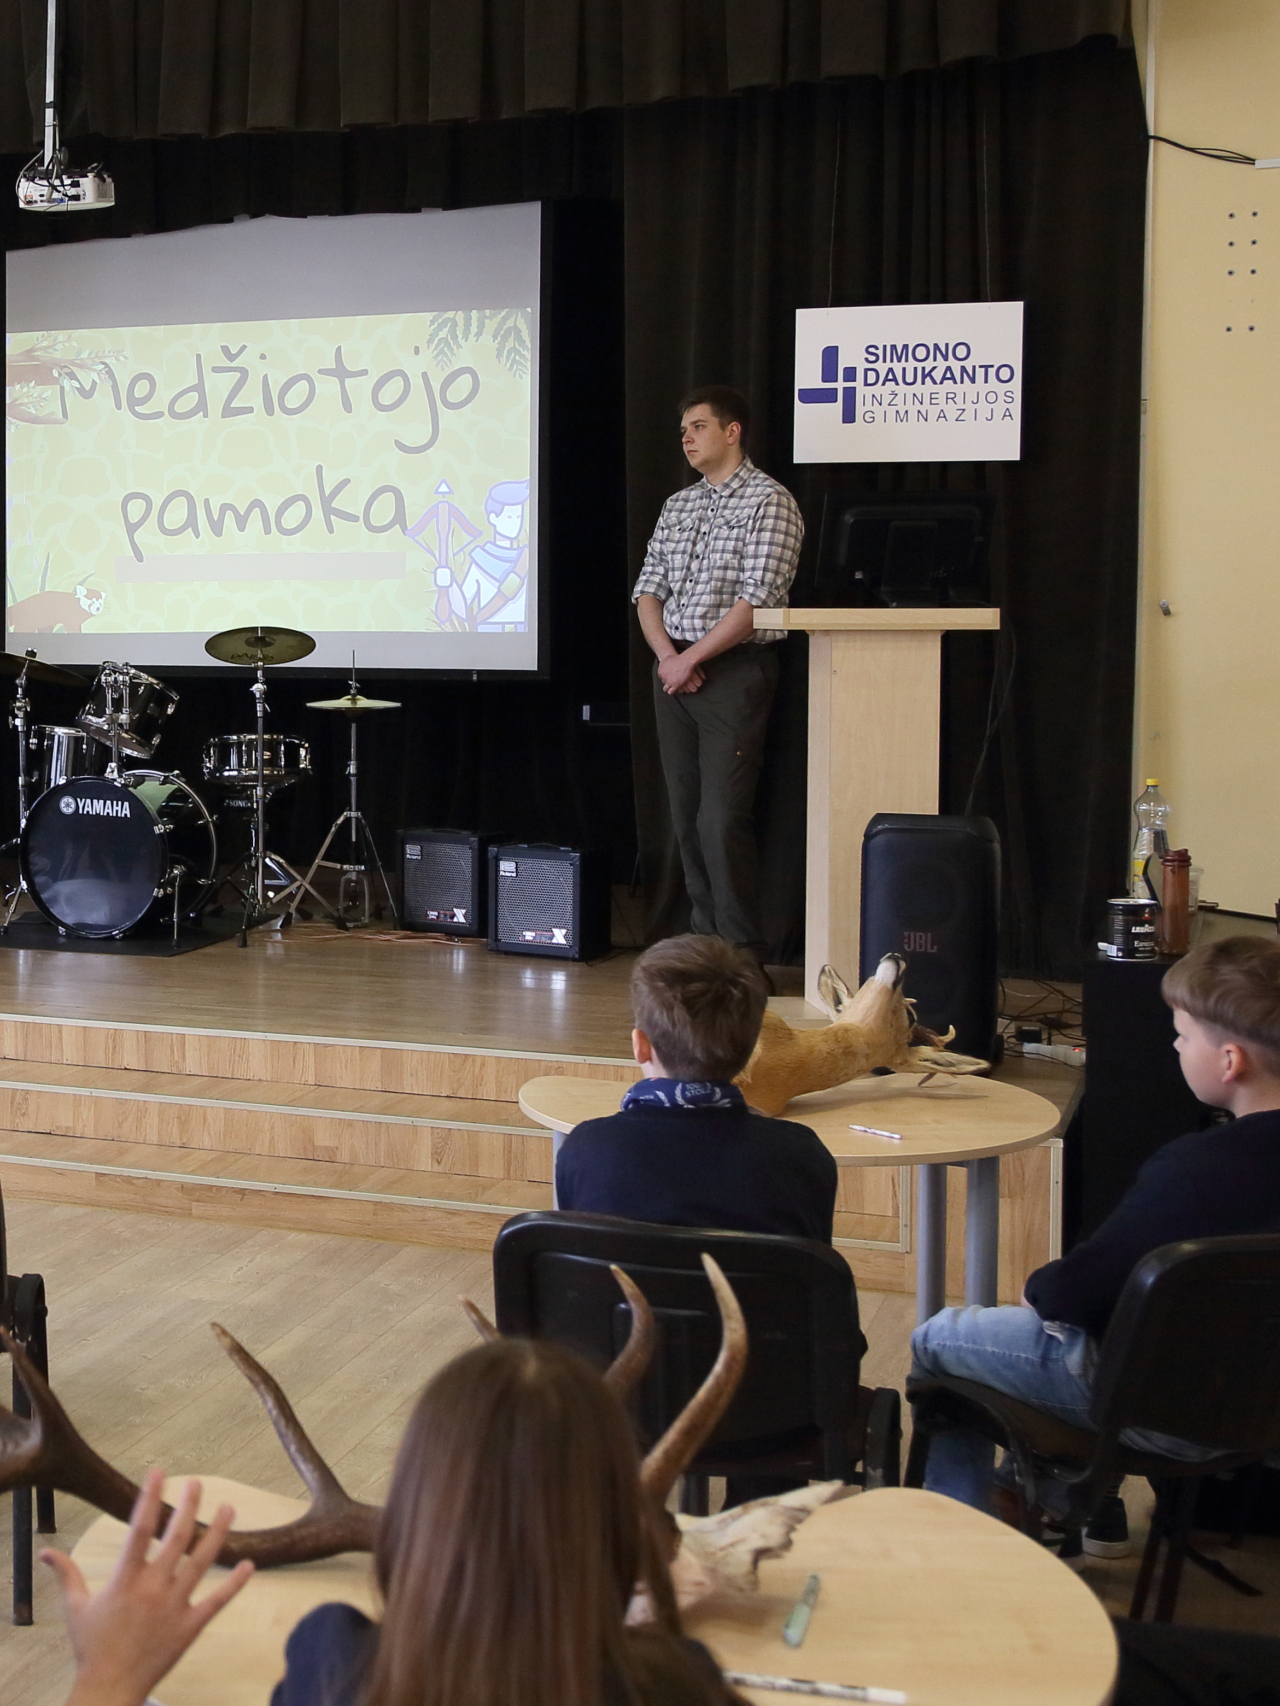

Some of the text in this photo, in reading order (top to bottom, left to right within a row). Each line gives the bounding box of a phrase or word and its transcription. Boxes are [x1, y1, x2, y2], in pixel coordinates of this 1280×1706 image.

[863, 341, 972, 364] SIMONO
[863, 363, 1015, 387] DAUKANTO
[59, 344, 481, 455] Medžiotojo
[862, 390, 1015, 407] INŽINERIJOS
[862, 407, 1014, 424] GIMNAZIJA
[120, 464, 409, 563] pamoka
[76, 797, 131, 818] YAMAHA
[903, 931, 938, 953] JBL
